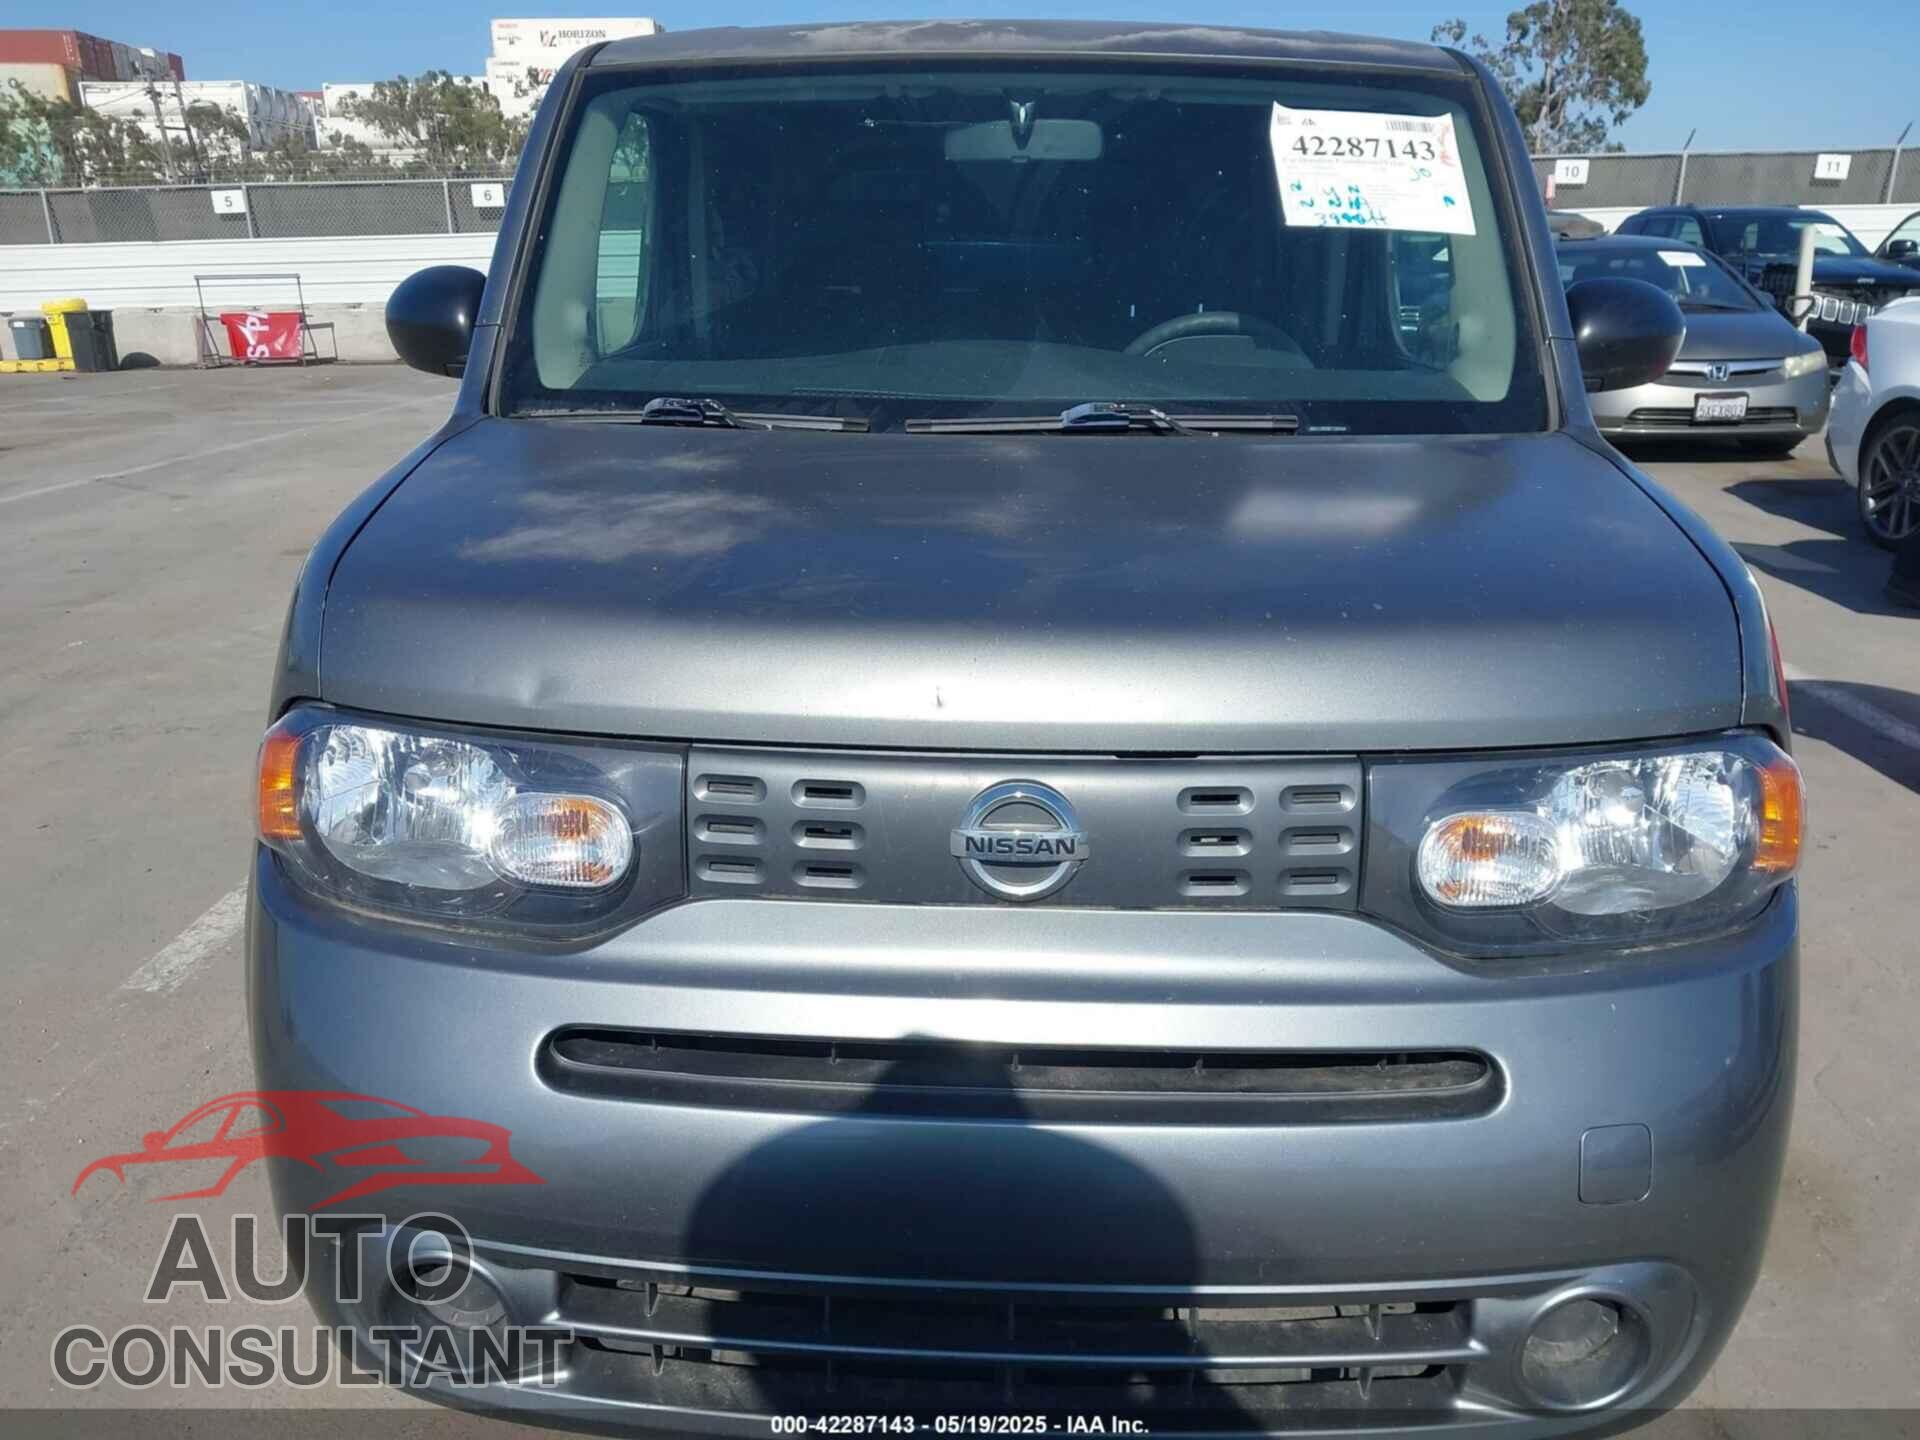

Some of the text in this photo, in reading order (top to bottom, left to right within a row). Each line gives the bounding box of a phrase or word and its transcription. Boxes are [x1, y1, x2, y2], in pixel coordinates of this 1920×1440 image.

[557, 29, 607, 39] HORIZON
[1292, 135, 1436, 161] 42287143
[1565, 166, 1580, 178] 10
[224, 195, 233, 208] 5
[484, 190, 493, 202] 6
[964, 836, 1076, 855] NISSAN
